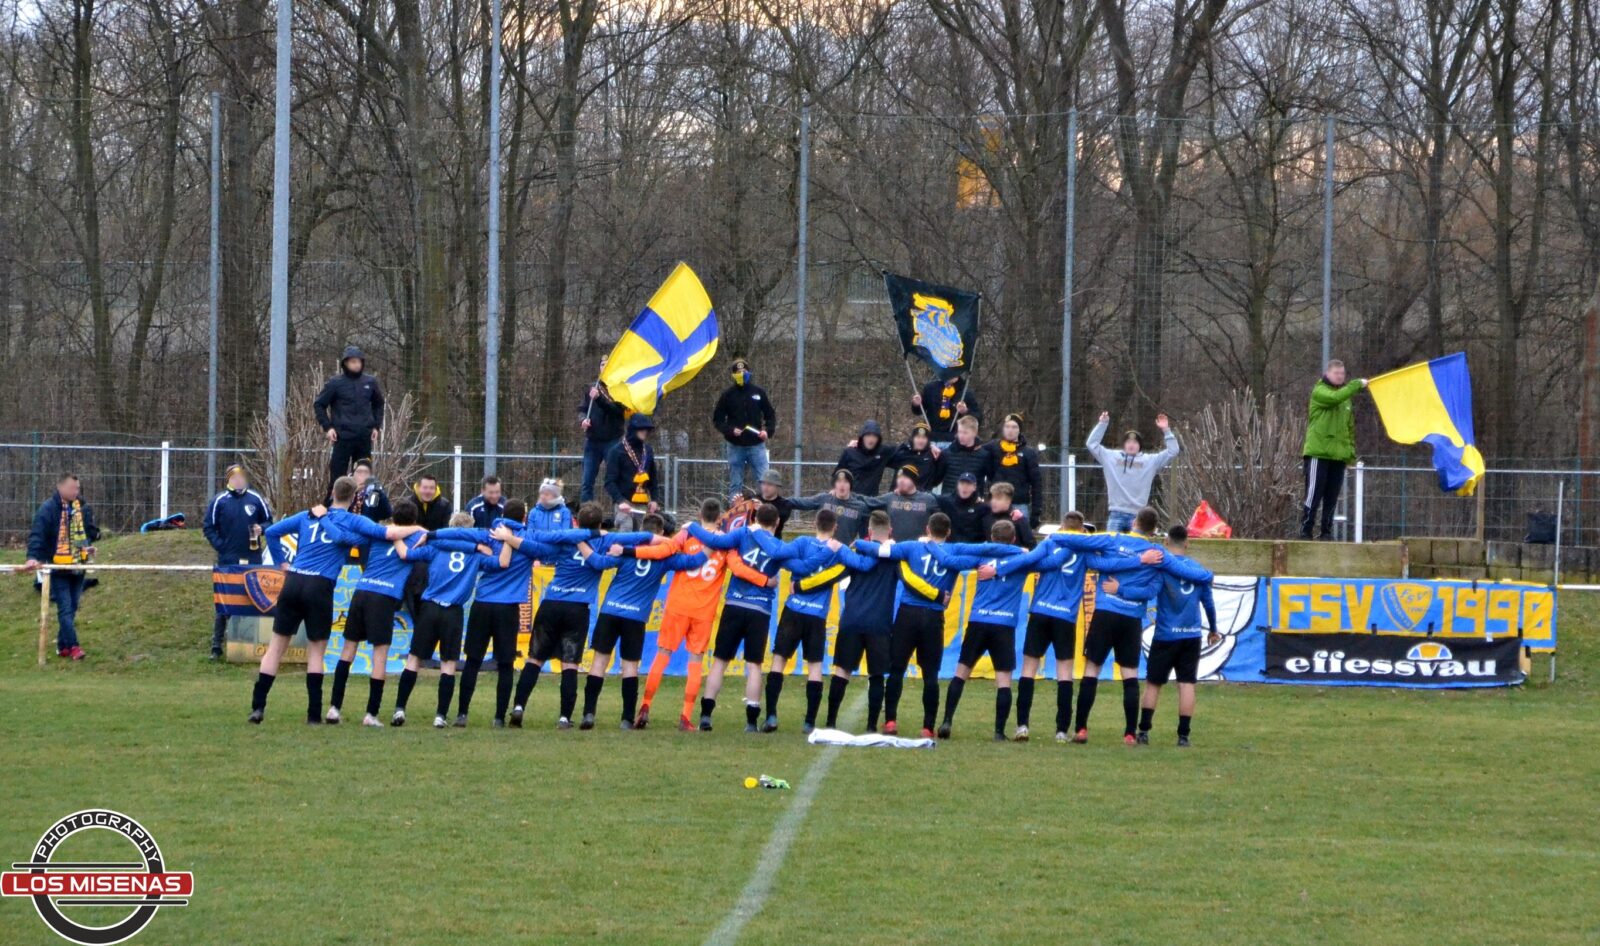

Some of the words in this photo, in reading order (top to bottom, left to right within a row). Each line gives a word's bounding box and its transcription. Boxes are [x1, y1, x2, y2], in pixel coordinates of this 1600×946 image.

[449, 551, 465, 573] 8
[634, 557, 653, 577] 9
[743, 547, 771, 573] 47
[1278, 583, 1376, 634] FSV
[1437, 586, 1555, 640] 1990
[1285, 649, 1498, 677] effessvau
